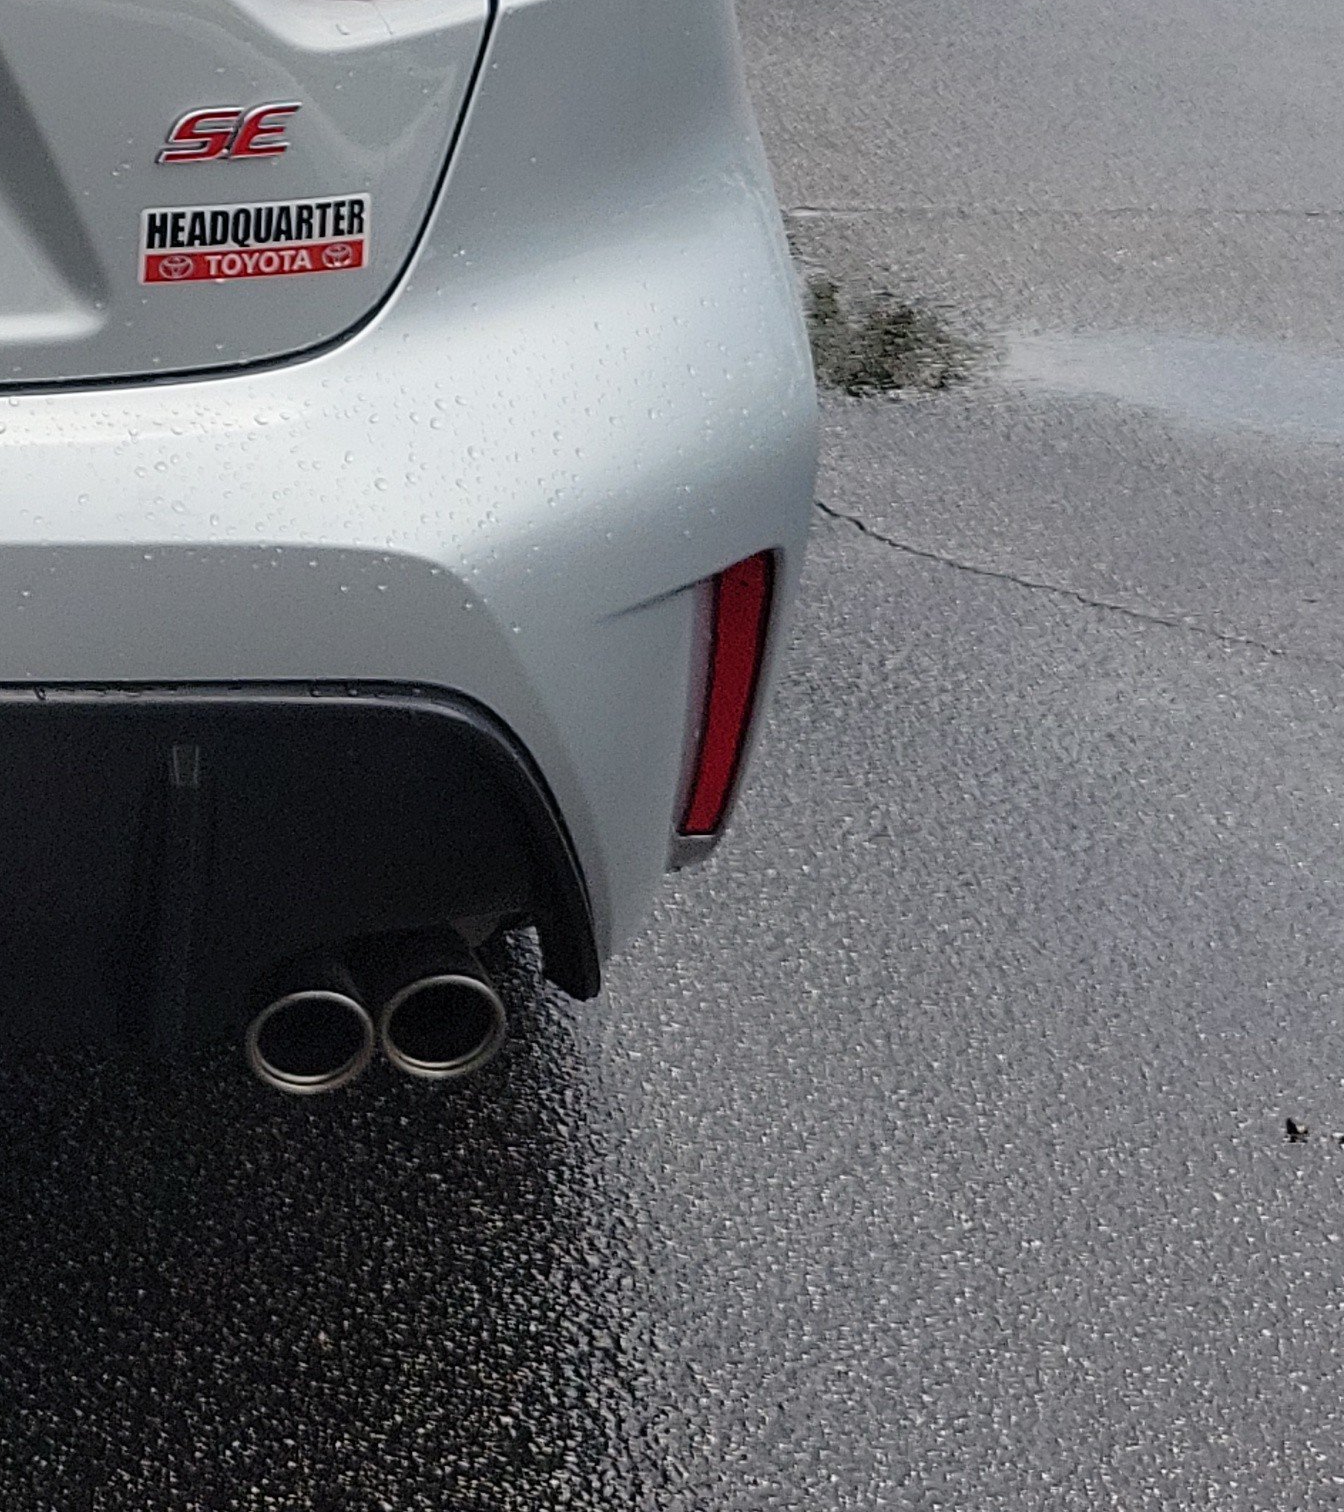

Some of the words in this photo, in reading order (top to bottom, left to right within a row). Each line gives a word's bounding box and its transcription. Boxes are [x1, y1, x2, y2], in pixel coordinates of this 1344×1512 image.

[155, 100, 303, 165] SE
[146, 199, 366, 249] HEADQUARTER
[204, 249, 313, 276] TOYOTA
